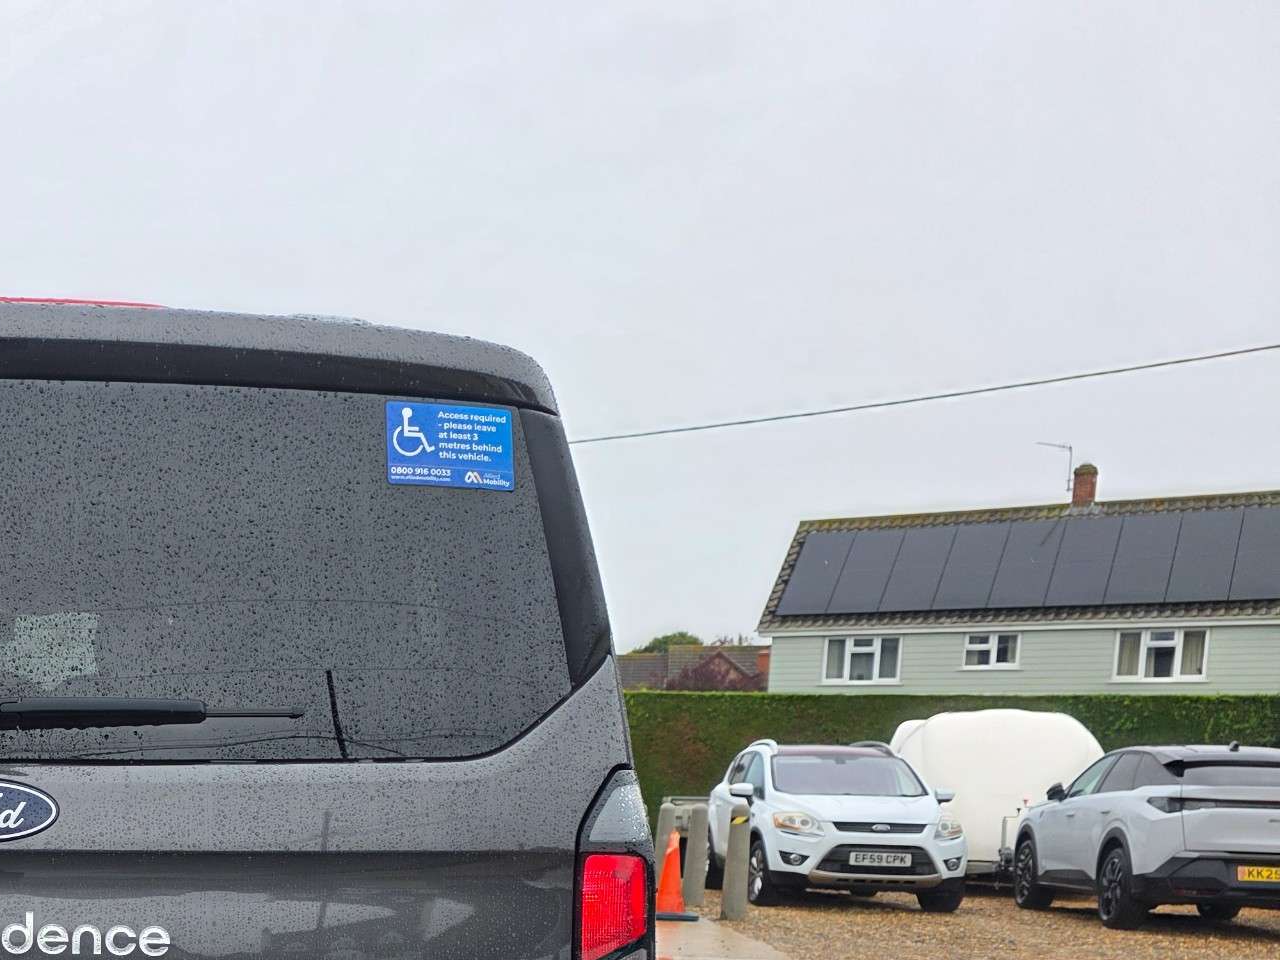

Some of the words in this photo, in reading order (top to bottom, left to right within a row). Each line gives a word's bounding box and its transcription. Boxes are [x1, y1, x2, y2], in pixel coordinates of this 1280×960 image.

[437, 411, 469, 421] Access
[470, 413, 507, 424] required
[443, 421, 472, 432] please
[474, 423, 497, 432] leave
[449, 431, 471, 441] least
[472, 433, 479, 441] 3
[438, 441, 471, 450] metres
[472, 443, 503, 453] behind
[438, 450, 457, 460] this
[458, 452, 492, 463] vehicle.
[390, 465, 413, 475] 0800
[430, 468, 452, 477] 0033
[483, 478, 510, 488] Mobility
[854, 853, 883, 864] EF59
[886, 854, 907, 865] CPK
